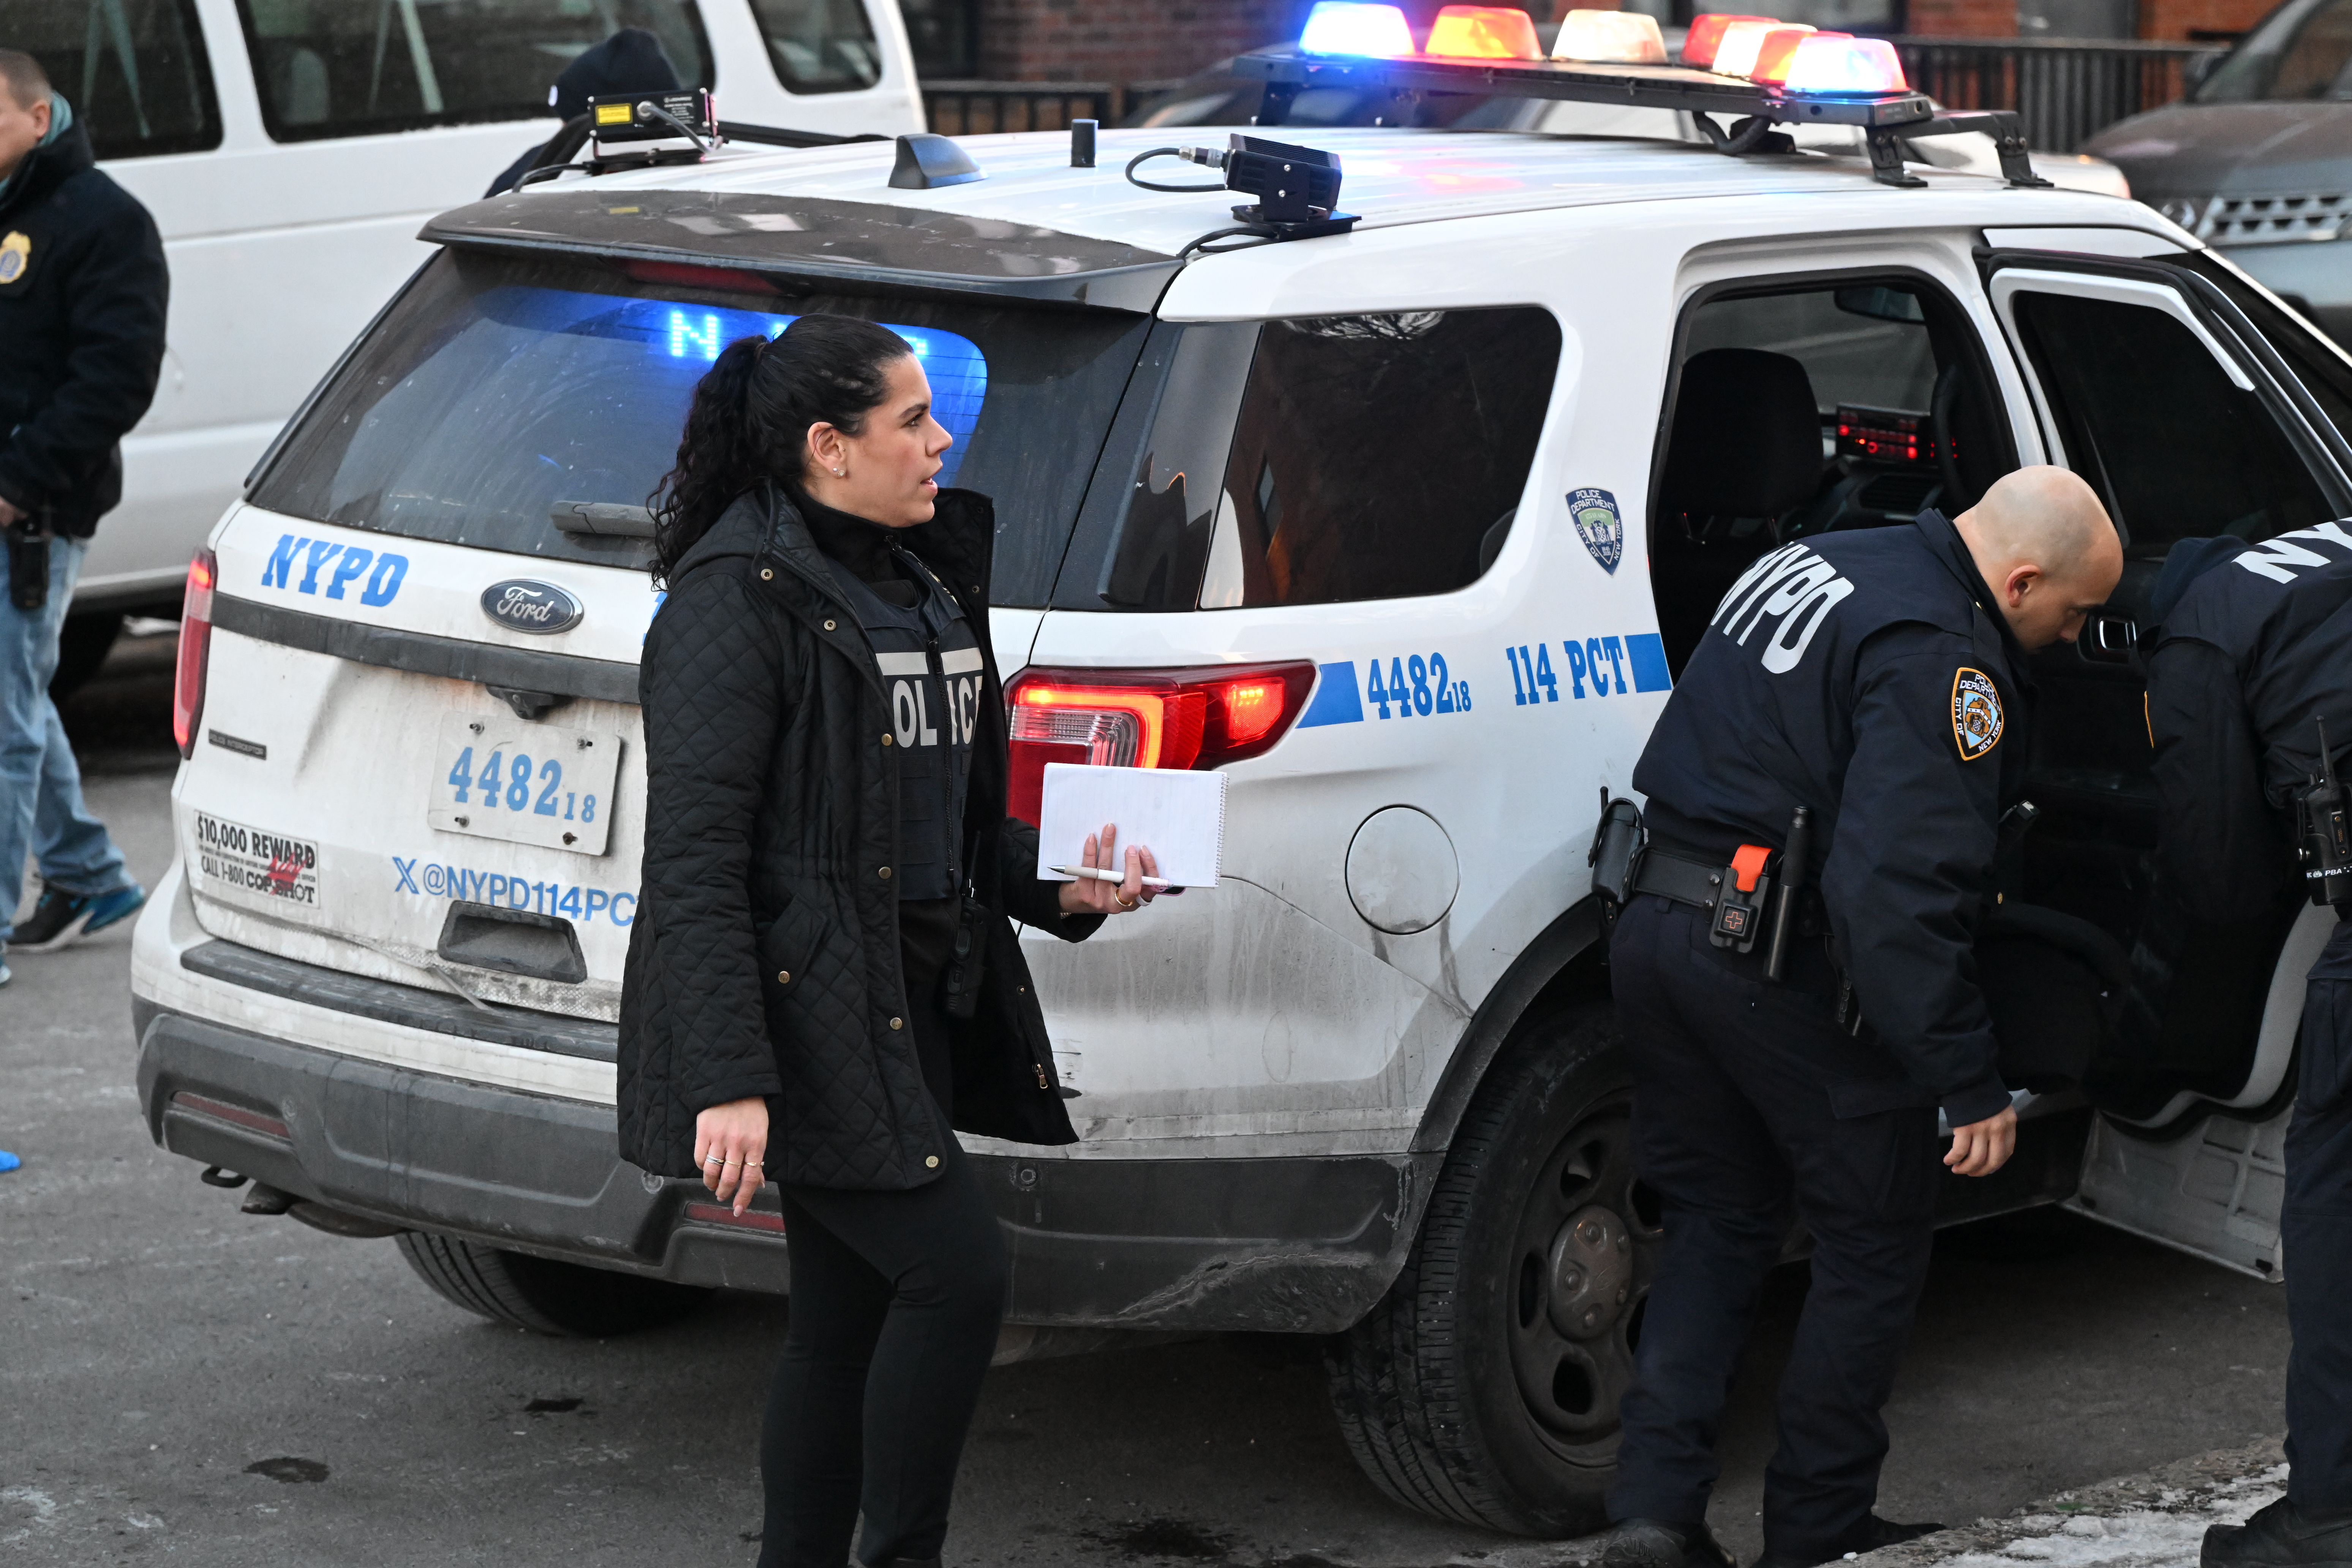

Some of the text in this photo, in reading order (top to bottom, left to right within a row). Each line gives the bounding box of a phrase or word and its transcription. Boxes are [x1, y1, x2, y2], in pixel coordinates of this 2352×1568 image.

[1571, 498, 1615, 515] DEPARTMENT
[1576, 490, 1601, 500] POLICE
[1576, 524, 1600, 558] CITY OF
[2230, 517, 2352, 584] NY
[261, 534, 409, 607] NYPD
[496, 586, 555, 622] Ford
[1710, 541, 1854, 674] NYPD
[1367, 635, 1628, 720] 4482 18 114 PCT
[1974, 674, 1995, 697] POLICE
[1960, 680, 2001, 714] DEPARTMENT
[1957, 723, 1964, 736] OF
[1978, 719, 2001, 752] NEW YORK
[449, 747, 596, 823] 4482 18
[198, 812, 315, 869] $10,000 REWARD
[201, 855, 219, 878] CALL
[221, 861, 244, 885] 1-800
[423, 863, 639, 927] @NYPD114PC
